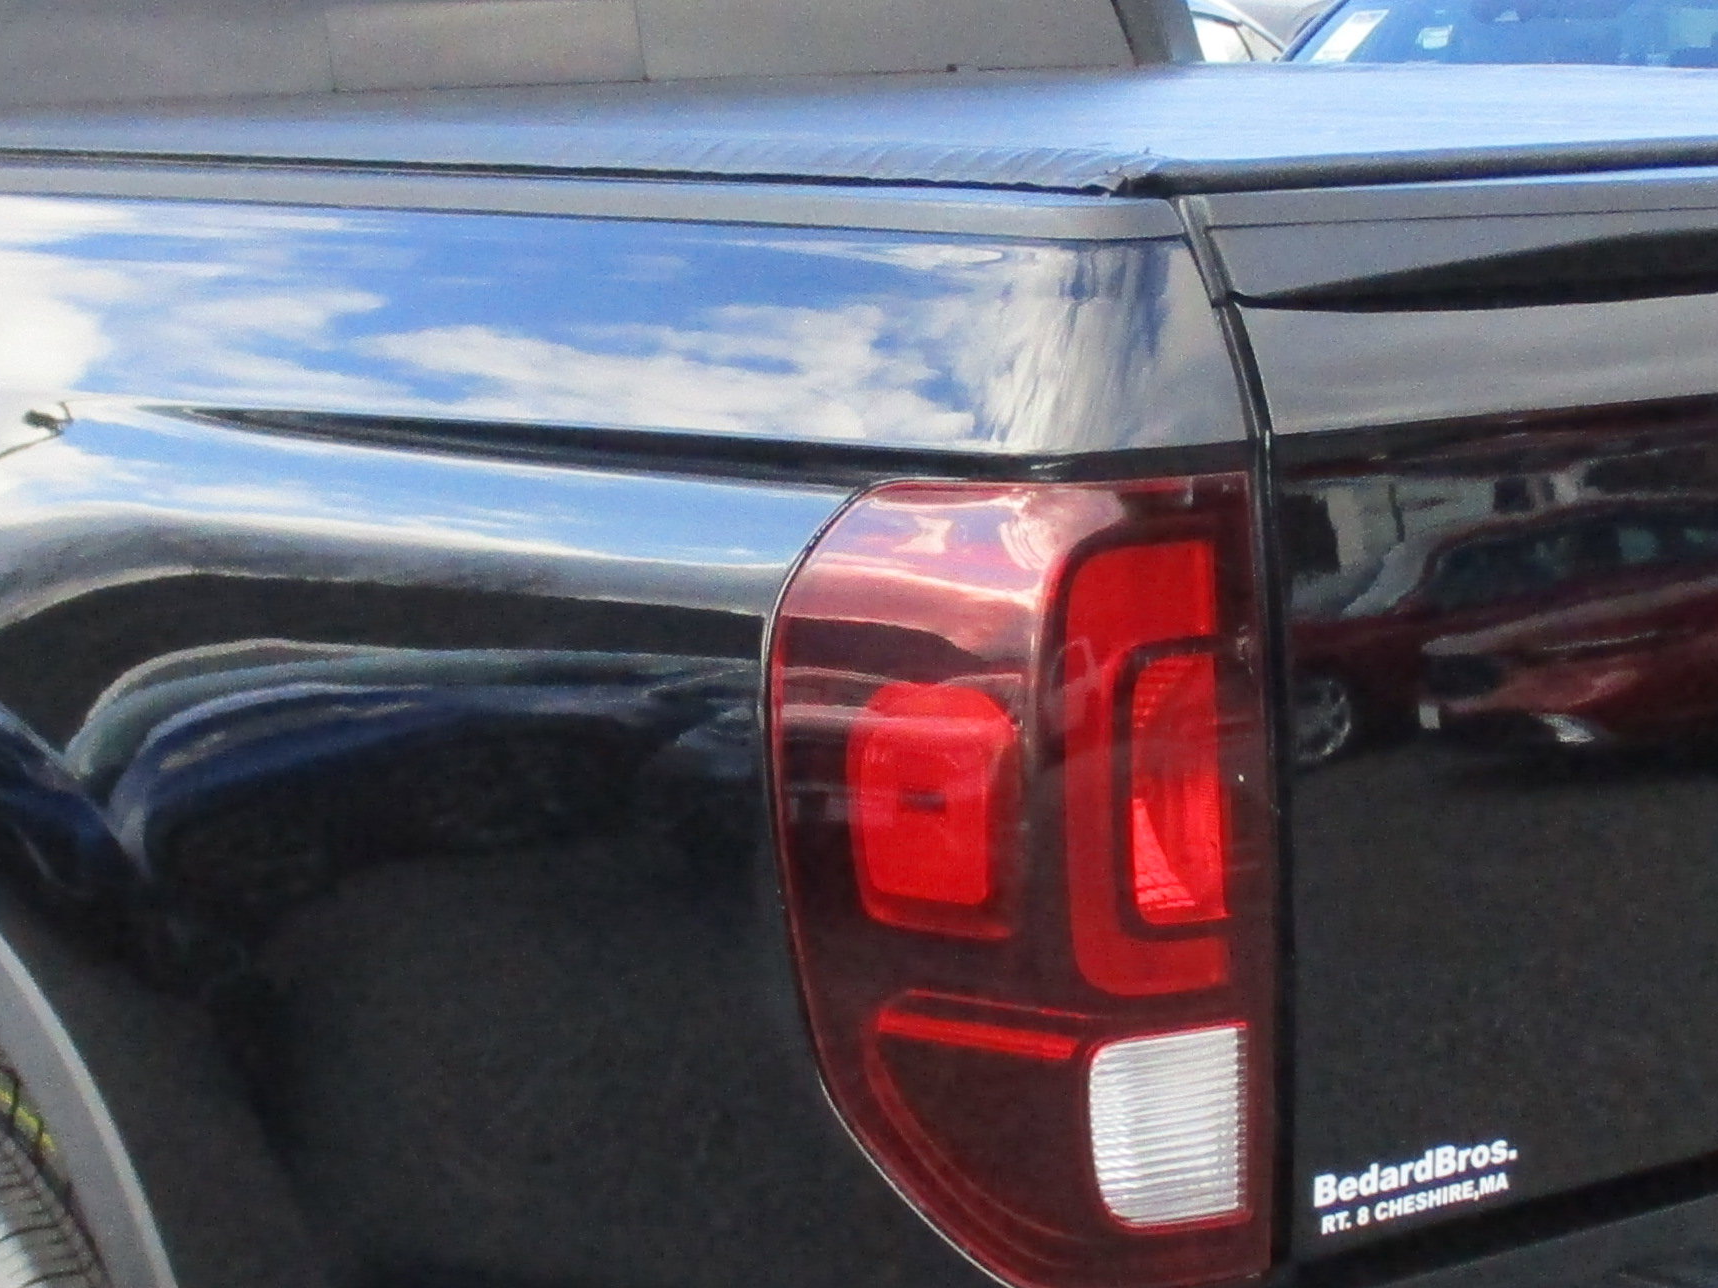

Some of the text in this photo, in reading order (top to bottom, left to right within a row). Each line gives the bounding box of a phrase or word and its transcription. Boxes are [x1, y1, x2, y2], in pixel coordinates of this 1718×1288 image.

[1313, 1139, 1518, 1208] BedardBros.
[1321, 1213, 1352, 1235] RT.
[1356, 1206, 1370, 1226] 8
